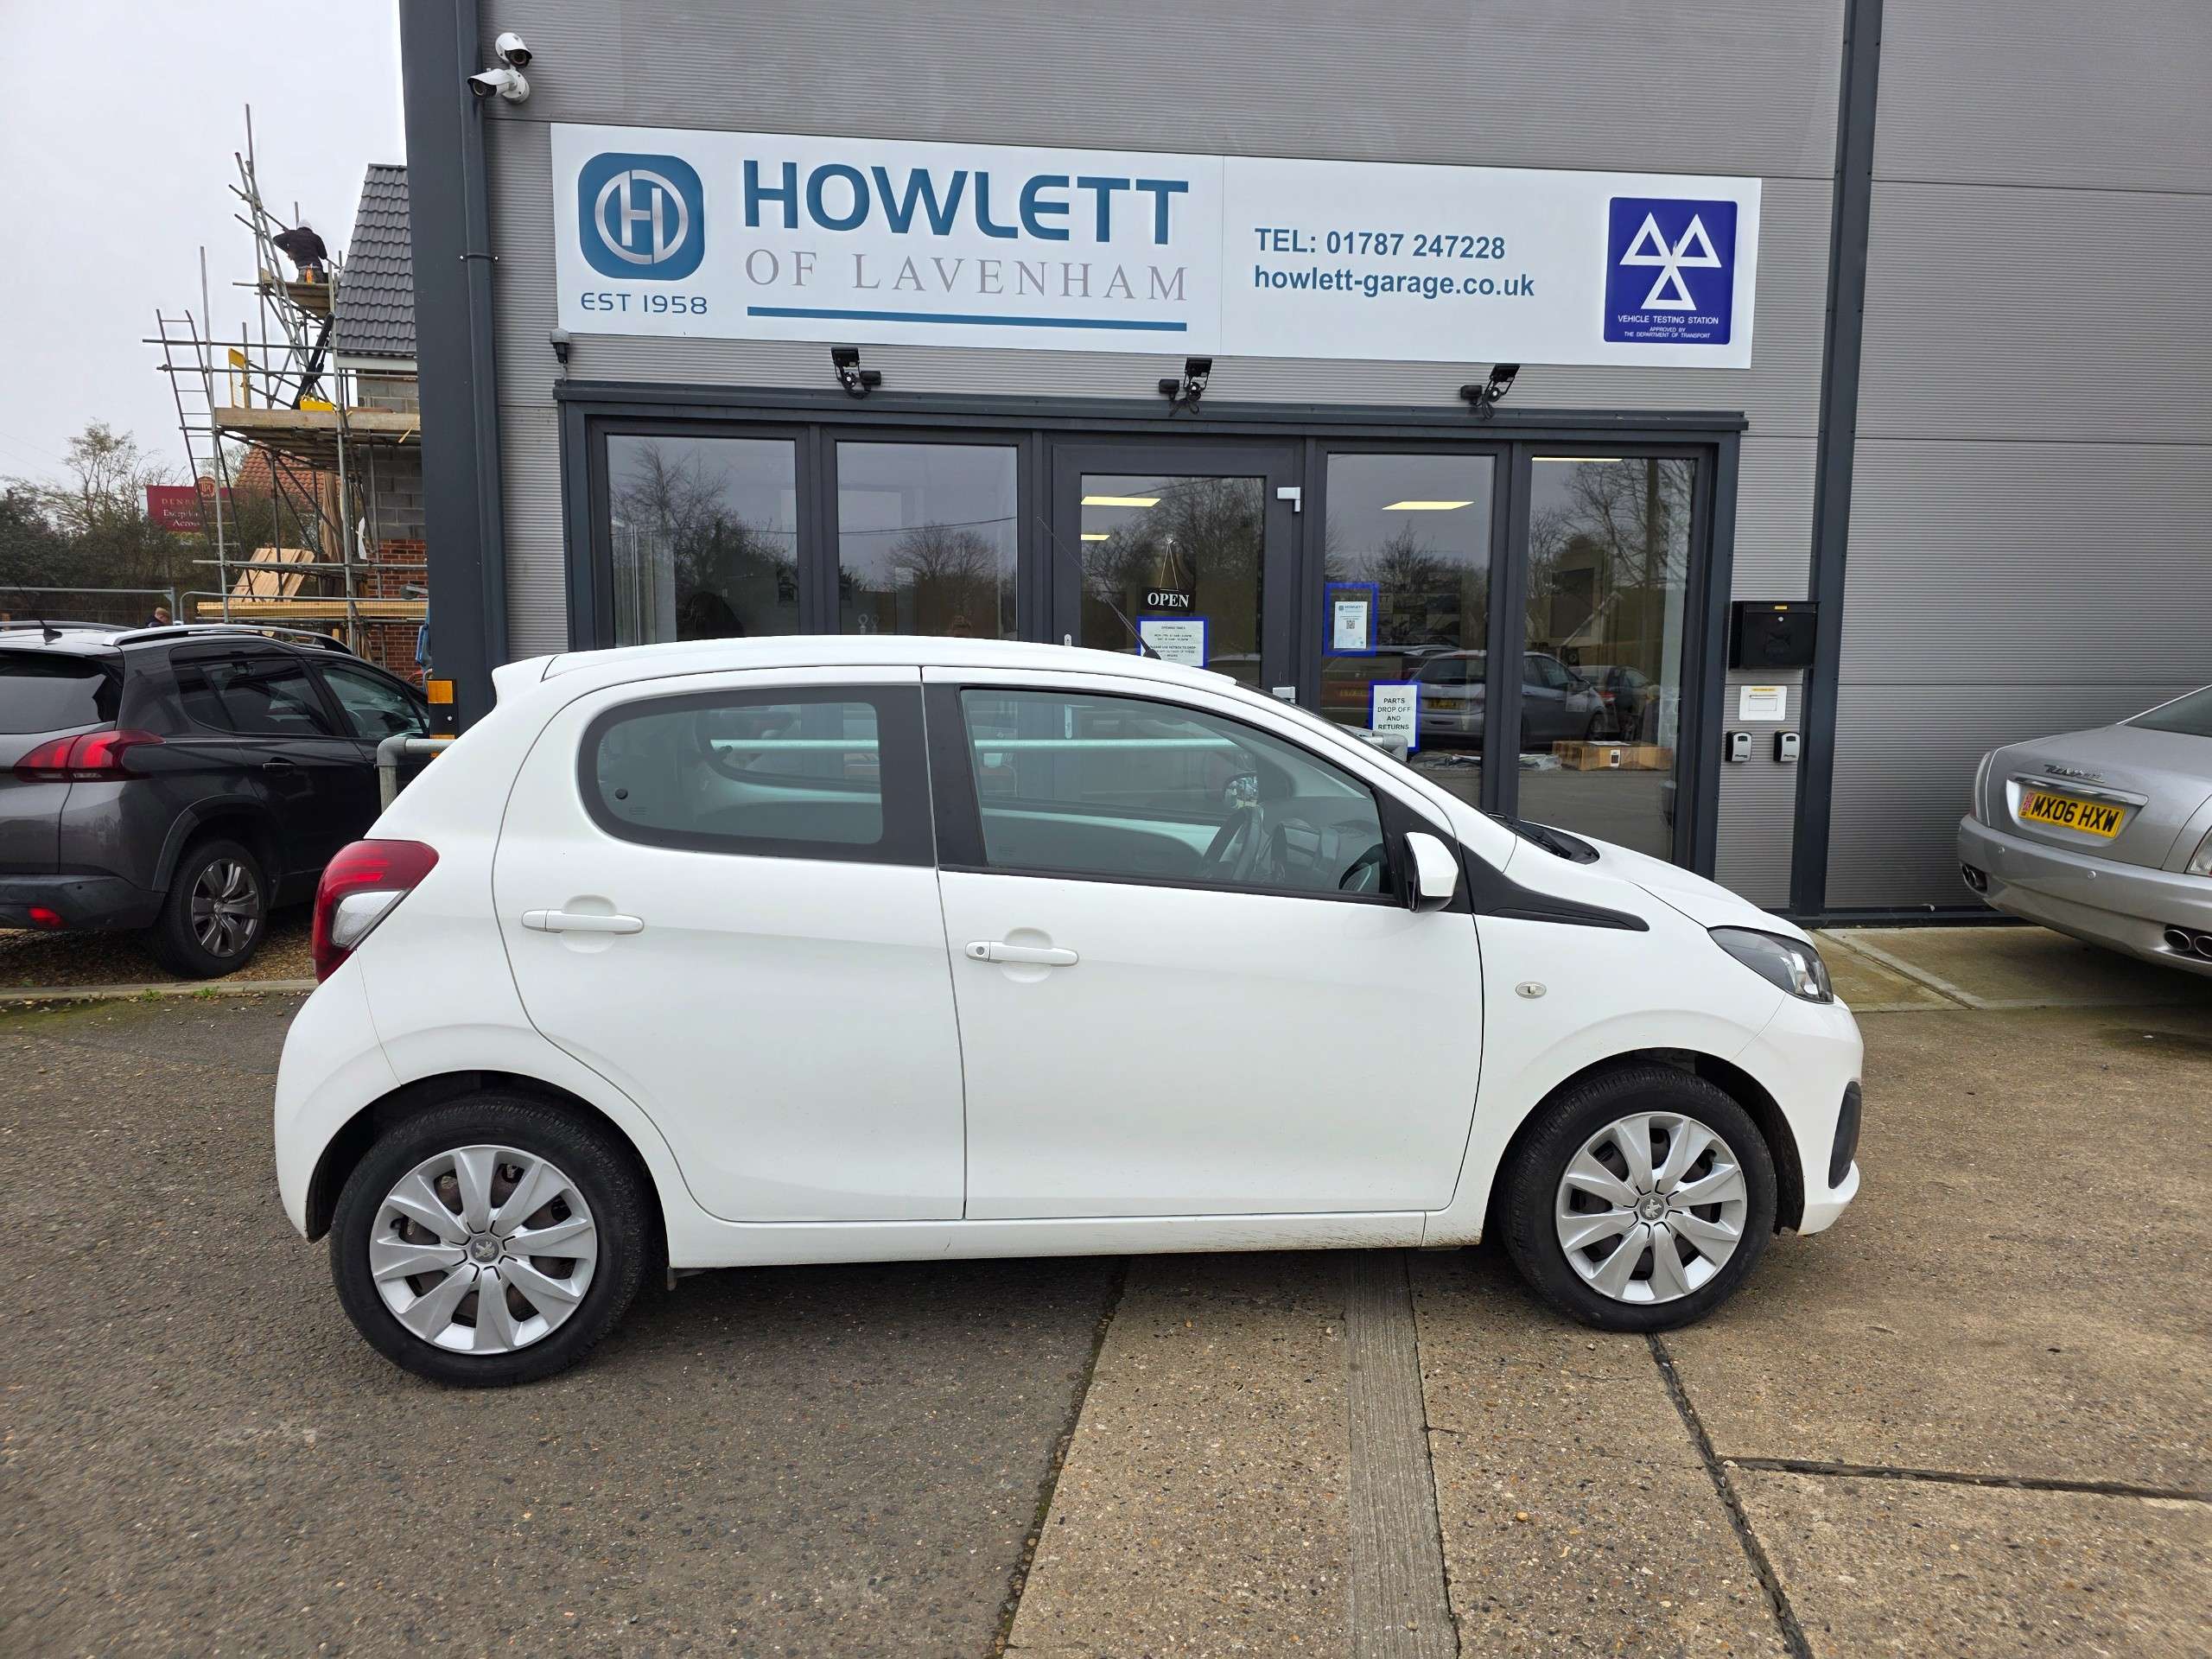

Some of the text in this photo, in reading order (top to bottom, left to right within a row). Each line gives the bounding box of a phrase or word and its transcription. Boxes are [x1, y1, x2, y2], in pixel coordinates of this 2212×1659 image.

[743, 159, 1189, 245] HOWLETT
[1254, 228, 1506, 260] TEL: 01787 247228
[745, 248, 1188, 302] OF LAVENHAM
[1254, 265, 1535, 298] howlett-garage.co.uk
[580, 291, 708, 315] EST 1958
[1618, 315, 1719, 325] VEHICLE TESTING STATION
[1147, 592, 1190, 608] OPEN
[2031, 795, 2120, 832] MX06 HXW
